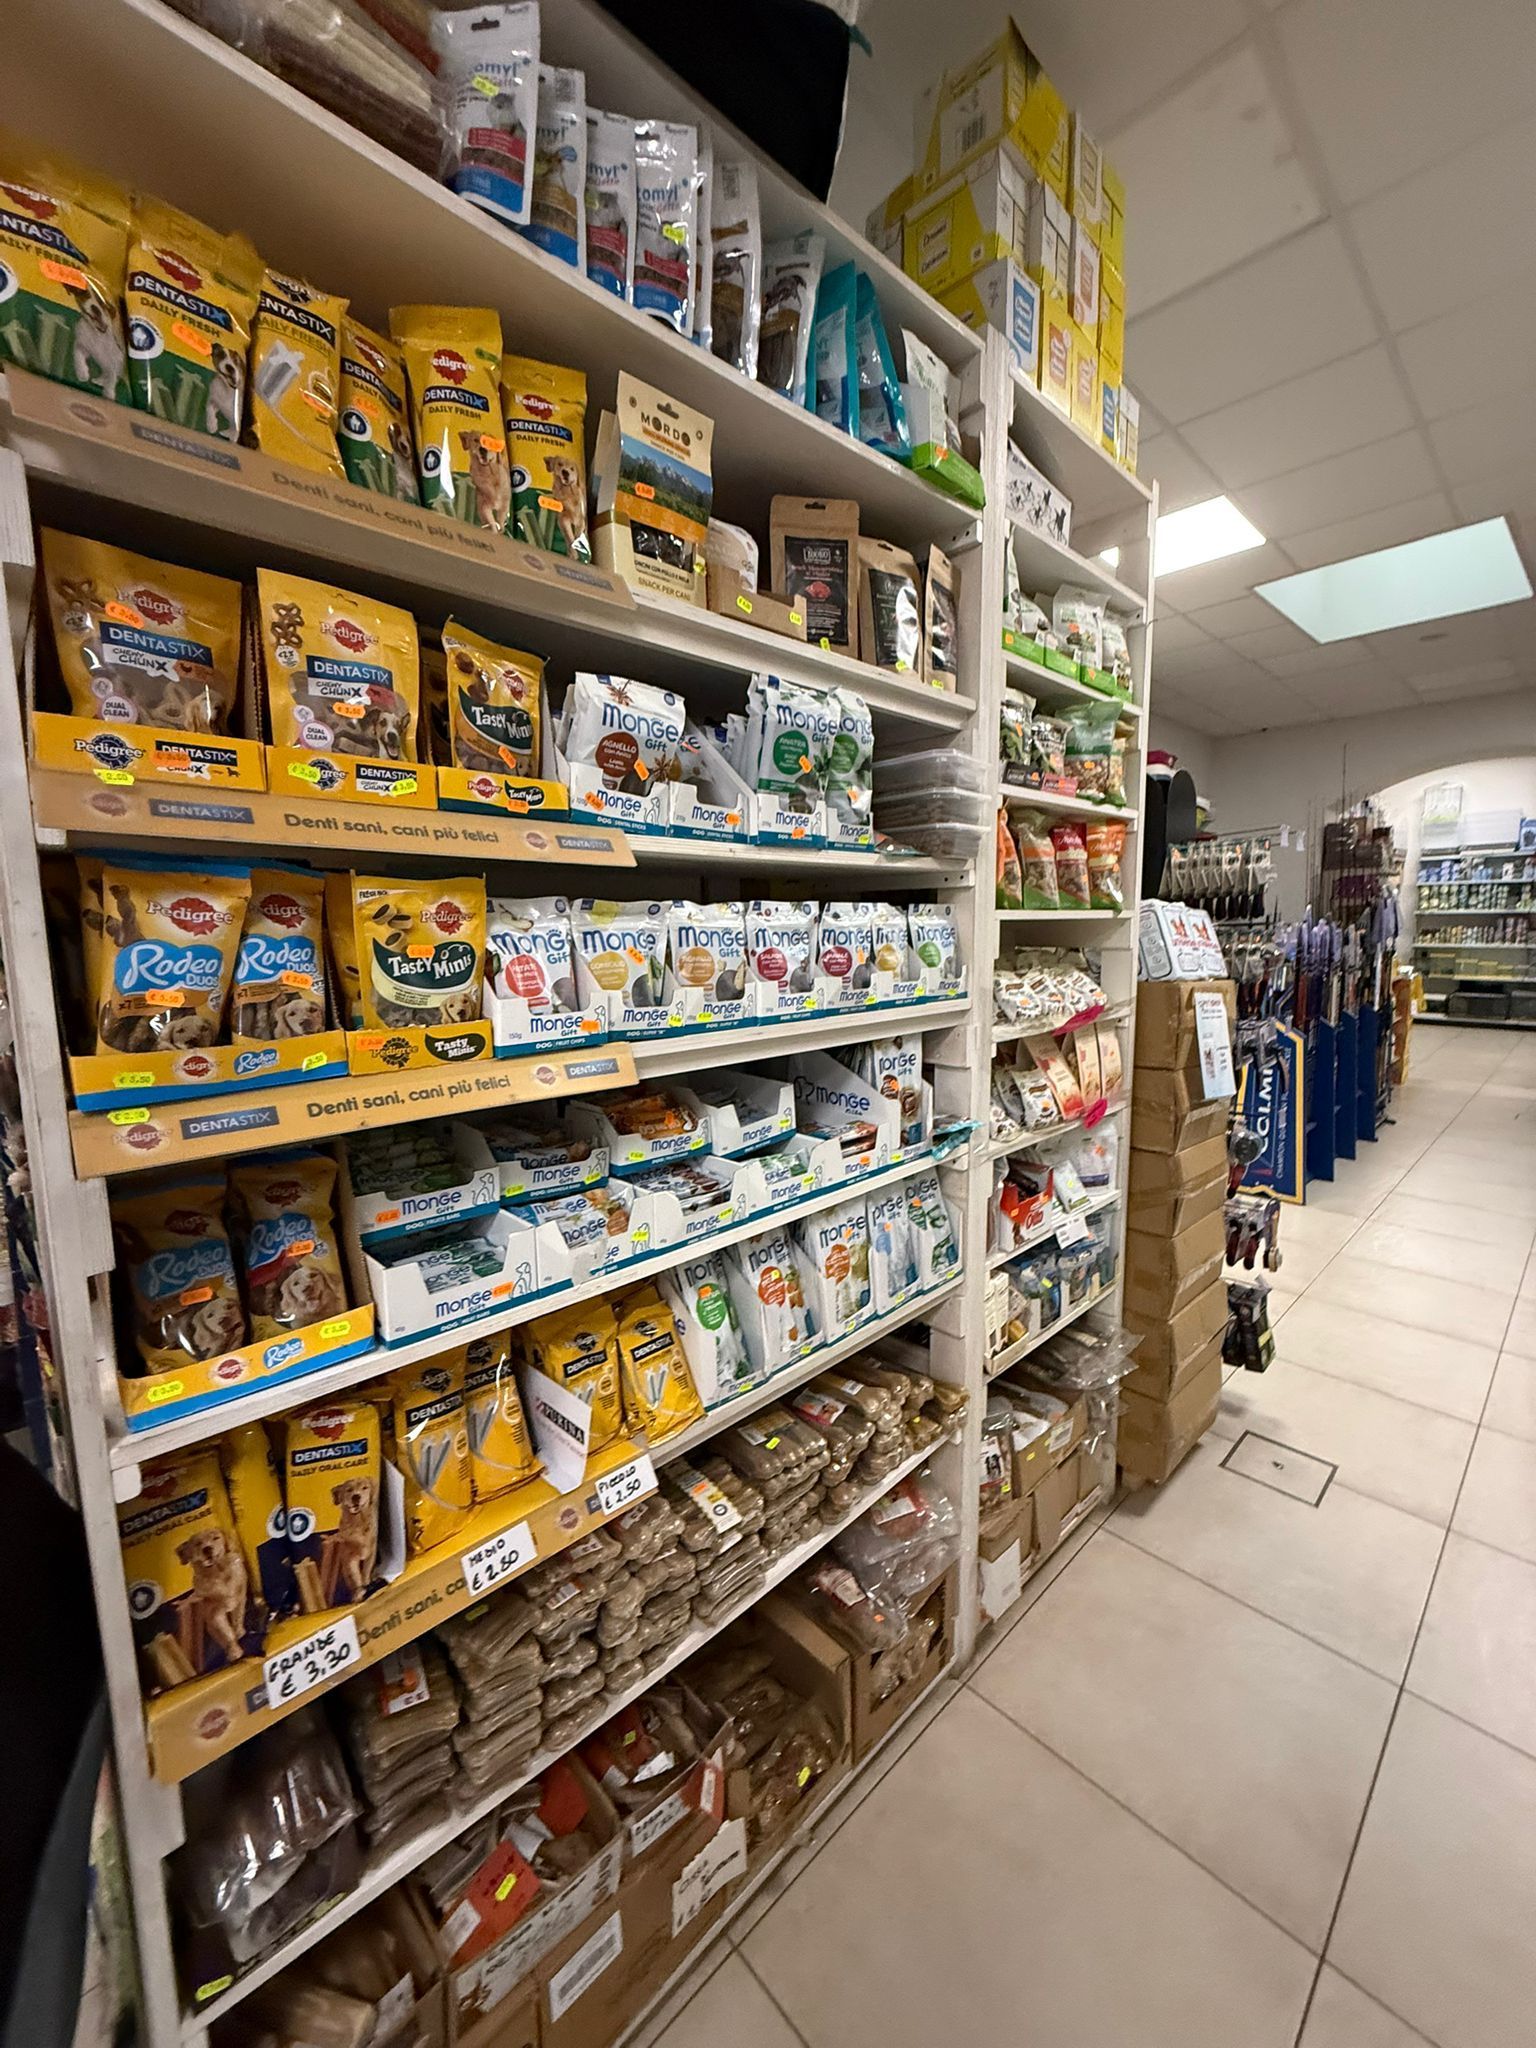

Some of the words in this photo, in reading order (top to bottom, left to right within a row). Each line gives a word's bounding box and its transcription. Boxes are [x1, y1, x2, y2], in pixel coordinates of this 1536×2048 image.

[134, 275, 227, 329] DENTASTIX
[424, 389, 486, 411] DENTASTIX
[429, 405, 452, 414] DAILY
[455, 407, 481, 420] FRESH
[511, 420, 571, 440] DENTASTIX
[516, 433, 540, 444] DAILY
[271, 472, 329, 498] Denti
[382, 507, 423, 530] cani
[109, 627, 206, 660] DENTASTIX
[119, 655, 168, 673] CHUNX
[314, 661, 390, 684] DENTASTIX
[321, 686, 362, 698] CHUNX
[103, 708, 130, 719] CLEAN
[106, 701, 127, 711] DUAL
[472, 706, 507, 728] Tasty
[306, 732, 328, 742] CLEAN
[307, 727, 325, 735] DUAL
[812, 732, 830, 745] Gift
[74, 739, 144, 758] Pedigree
[602, 739, 637, 754] AGNELLO
[645, 739, 667, 752] Gift
[158, 804, 246, 820] DENTASTIX
[620, 810, 634, 819] Gift
[284, 814, 338, 830] Denti
[343, 819, 388, 835] sani,
[391, 824, 429, 837] cani
[434, 826, 458, 841] più
[463, 829, 499, 843] felici
[147, 900, 233, 924] Pedigree
[420, 910, 474, 923] Pedigree
[236, 937, 312, 982] Rodeo
[719, 948, 740, 958] Gift
[123, 943, 219, 989] Rodeo
[388, 955, 433, 977] Tasty
[433, 953, 472, 979] Minis
[561, 1028, 578, 1036] Gift
[371, 1044, 419, 1057] Pedigree
[435, 1038, 468, 1053] Tasty
[447, 1045, 476, 1058] Minis
[238, 1051, 277, 1070] Rodeo
[307, 1098, 358, 1118] Denti
[363, 1091, 405, 1108] sani,
[408, 1085, 444, 1101] cani
[448, 1080, 471, 1097] più
[475, 1076, 511, 1091] felici
[189, 1111, 271, 1134] DENTASTIX
[436, 1205, 454, 1214] Gift
[405, 1220, 424, 1230] DOG
[148, 1247, 224, 1296] Rodeo
[295, 1438, 367, 1463] DENTASTIX
[319, 1463, 343, 1473] ORAL
[345, 1458, 368, 1468] CARE
[472, 1572, 483, 1590] €
[358, 1614, 402, 1645] Denti
[446, 1578, 467, 1596] ca
[281, 1678, 296, 1697] €
